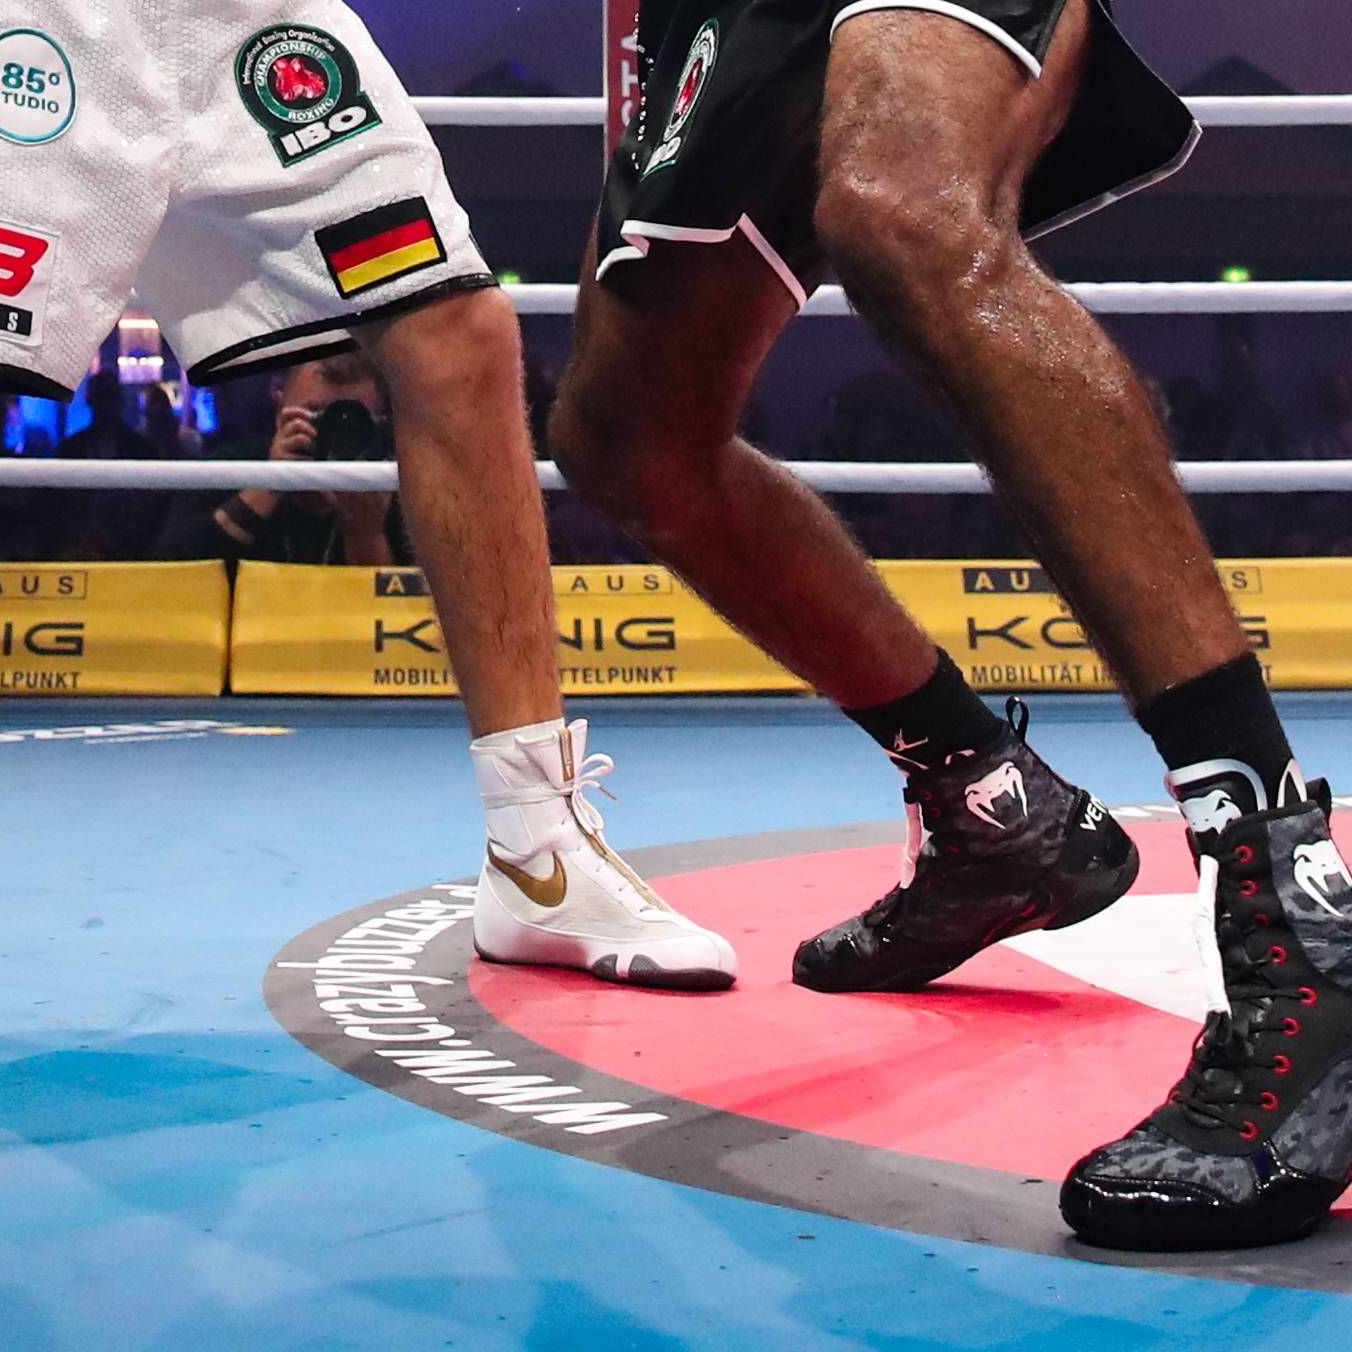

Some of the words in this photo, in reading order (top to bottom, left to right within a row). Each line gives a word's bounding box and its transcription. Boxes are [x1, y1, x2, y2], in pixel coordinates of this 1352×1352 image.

[255, 41, 327, 87] CHAMPIONSHIP
[288, 98, 335, 122] BOXING
[280, 106, 367, 156] IBO
[971, 663, 1083, 685] MOBILITÄT
